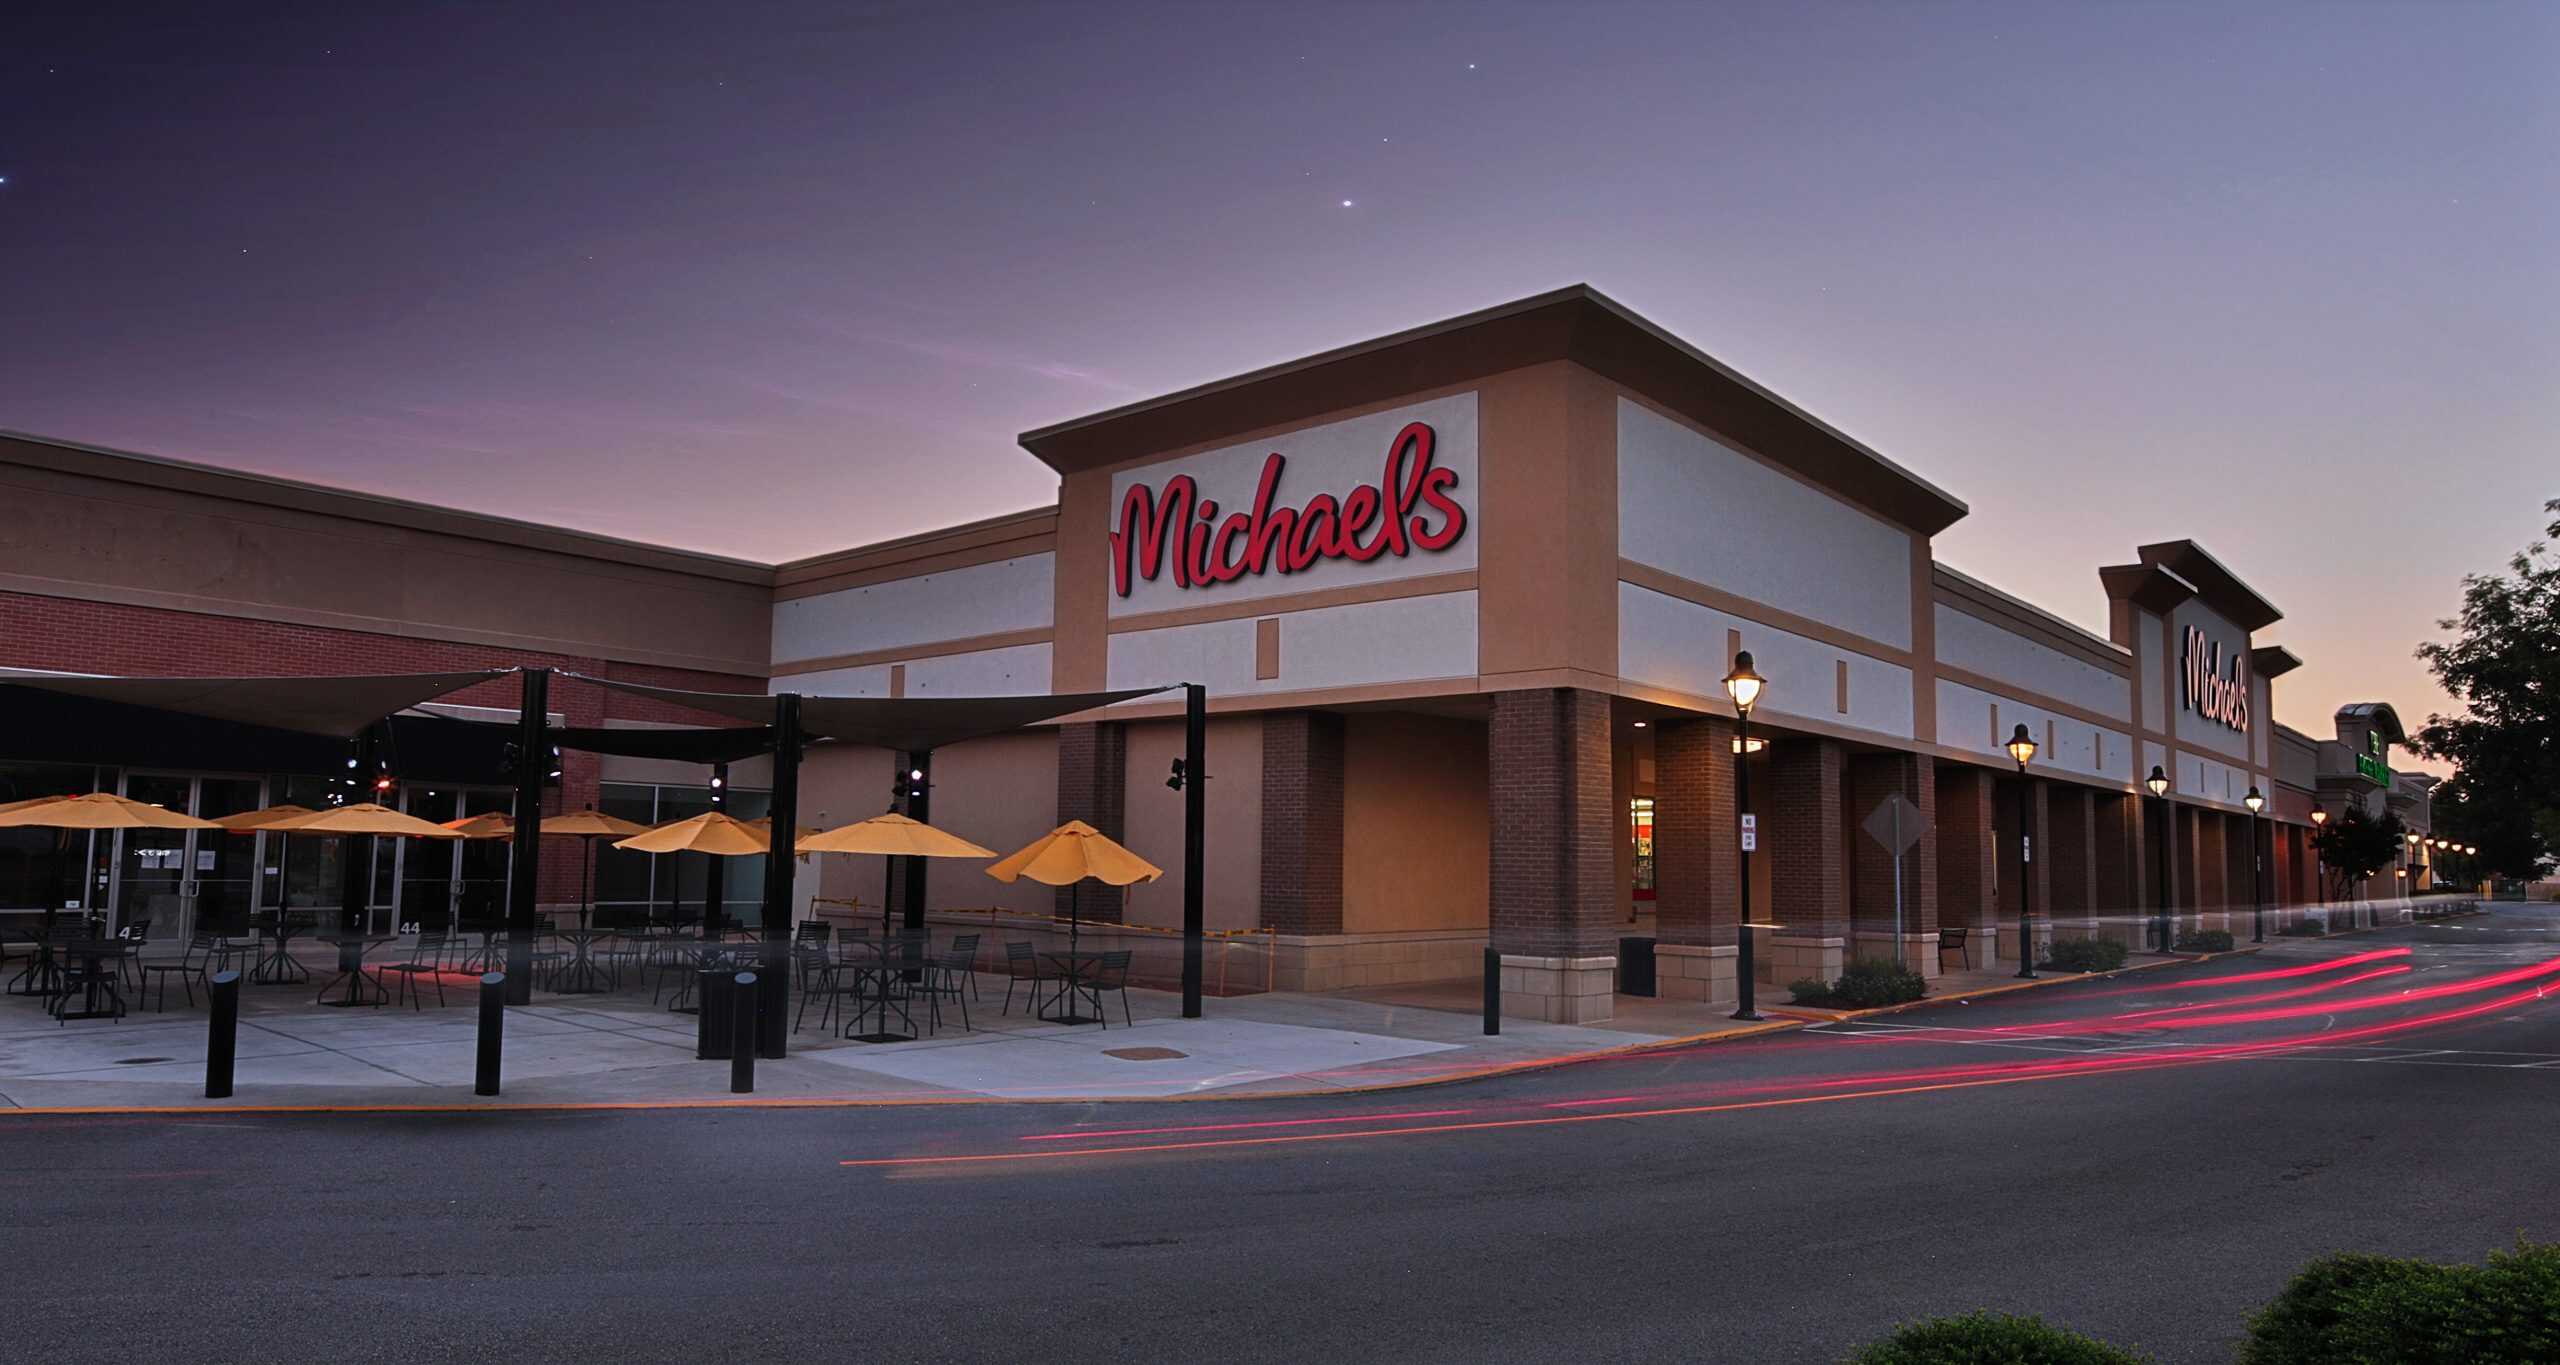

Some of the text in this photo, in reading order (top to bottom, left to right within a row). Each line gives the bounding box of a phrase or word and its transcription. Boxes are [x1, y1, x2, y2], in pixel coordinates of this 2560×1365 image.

[1109, 421, 1467, 599] Michaels
[2182, 623, 2248, 733] Michaels
[400, 921, 420, 935] 44
